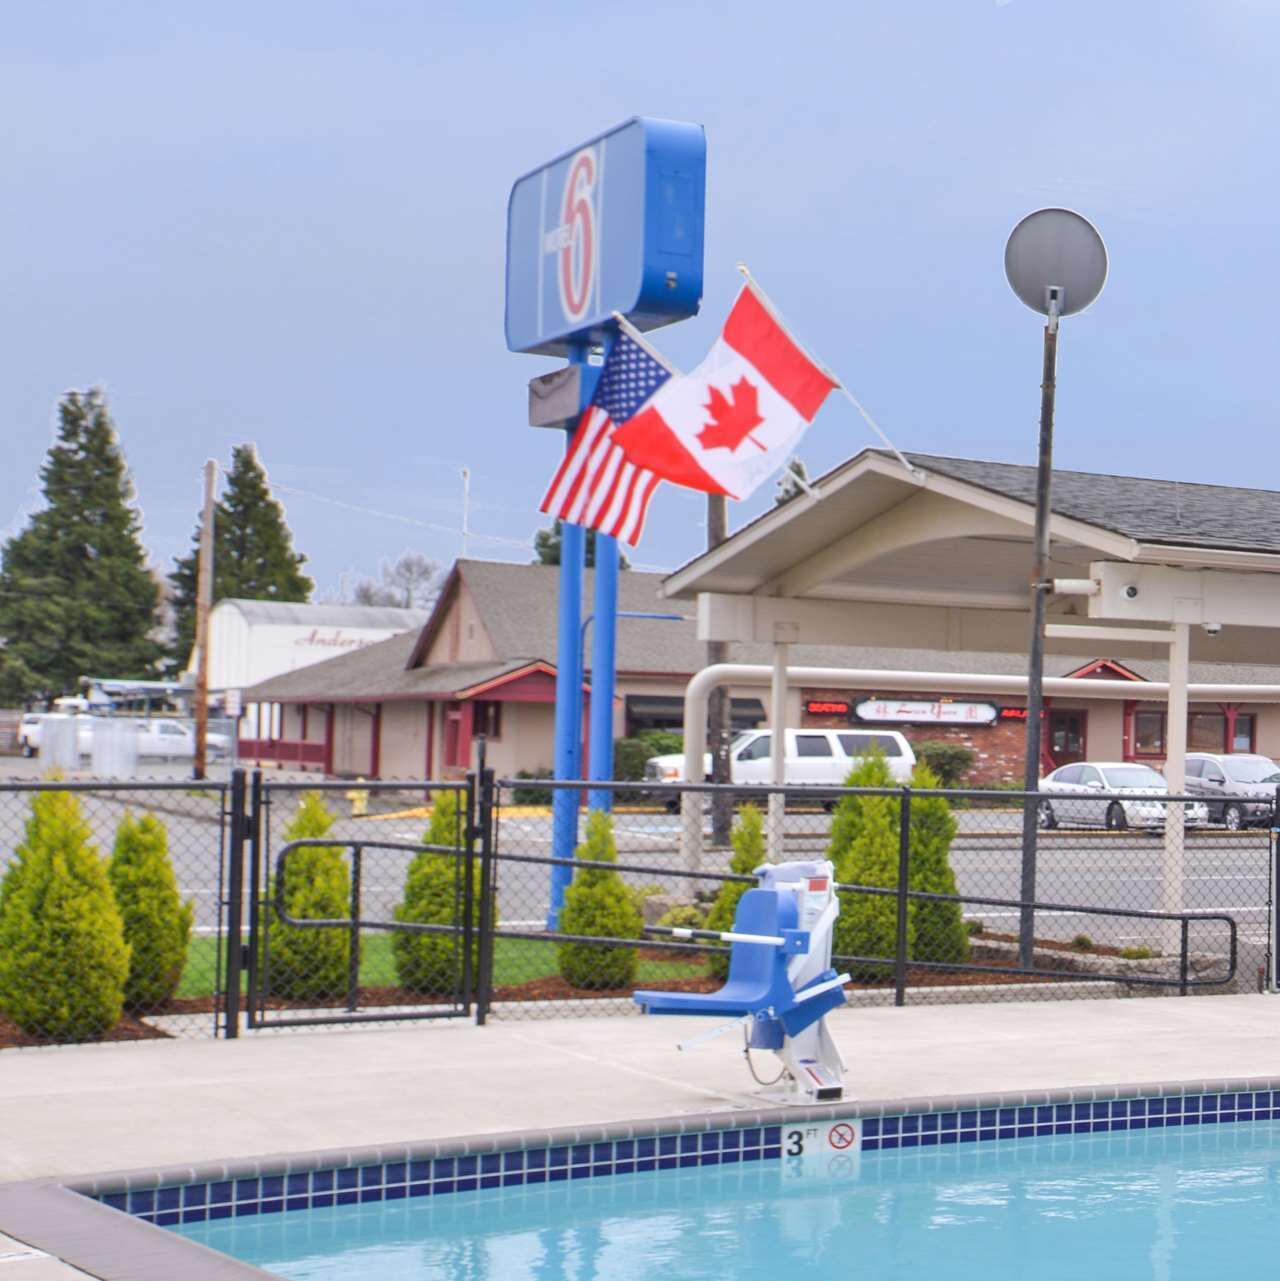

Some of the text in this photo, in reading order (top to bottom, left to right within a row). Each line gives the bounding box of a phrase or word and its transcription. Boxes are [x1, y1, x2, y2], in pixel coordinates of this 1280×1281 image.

[561, 152, 594, 318] 6
[787, 1128, 819, 1156] 3 FT
